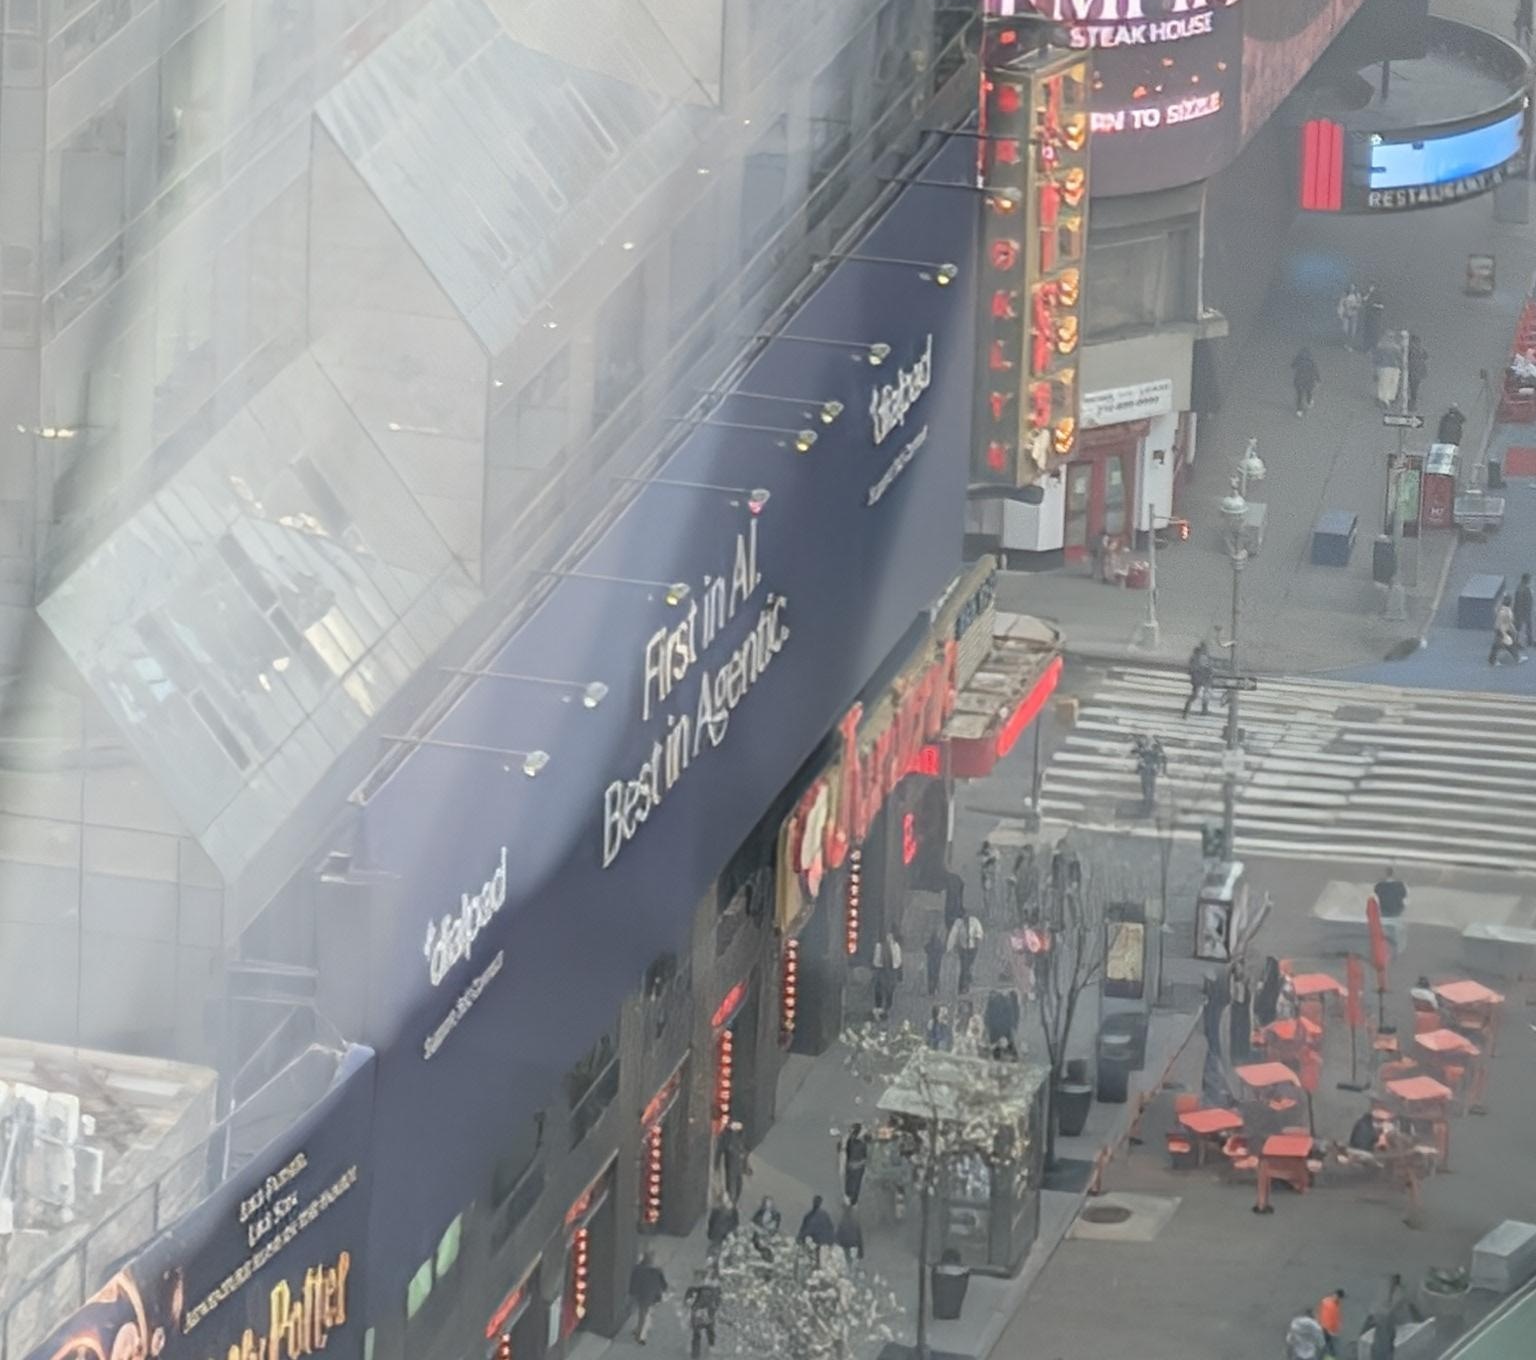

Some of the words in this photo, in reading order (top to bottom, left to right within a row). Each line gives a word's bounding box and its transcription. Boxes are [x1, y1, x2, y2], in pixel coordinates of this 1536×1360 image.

[1069, 21, 1149, 49] STEAK
[1149, 10, 1215, 43] HOUSE
[1132, 108, 1160, 129] TO
[1166, 91, 1223, 125] SIZZLE
[644, 598, 698, 721] First
[702, 574, 727, 651] in
[603, 741, 663, 869] Best
[665, 713, 691, 790] in
